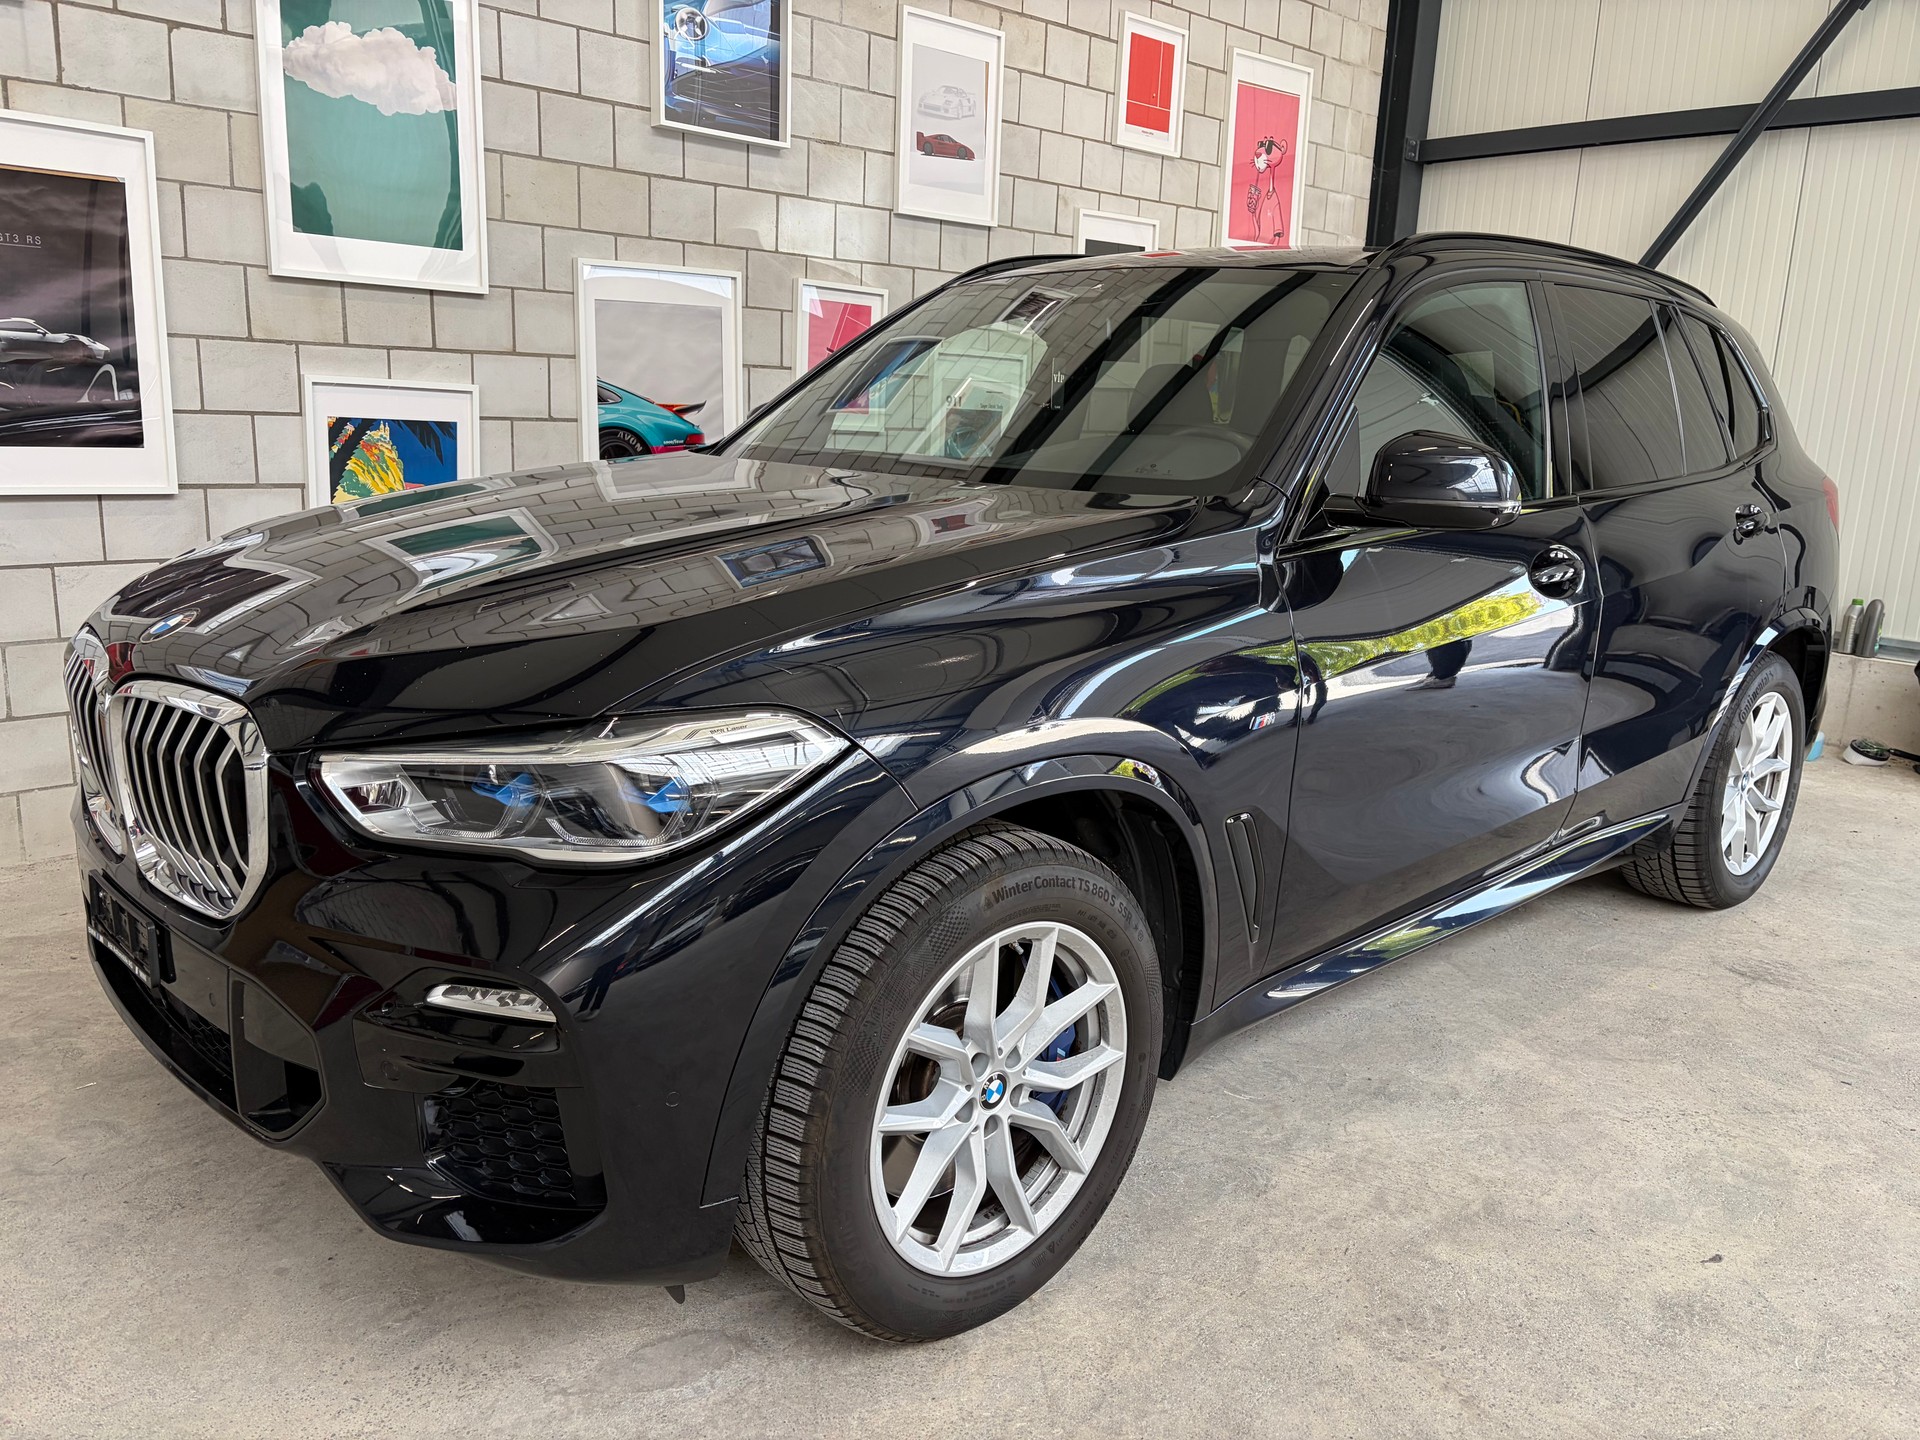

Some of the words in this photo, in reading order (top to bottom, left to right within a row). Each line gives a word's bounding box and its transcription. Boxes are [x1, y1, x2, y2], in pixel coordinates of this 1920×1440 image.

[26, 235, 41, 245] RS
[617, 431, 643, 452] AVON
[1739, 670, 1770, 725] Continental
[1078, 877, 1090, 892] TS
[1092, 883, 1109, 902] 860
[1109, 896, 1116, 907] S
[1118, 902, 1132, 925] SSR
